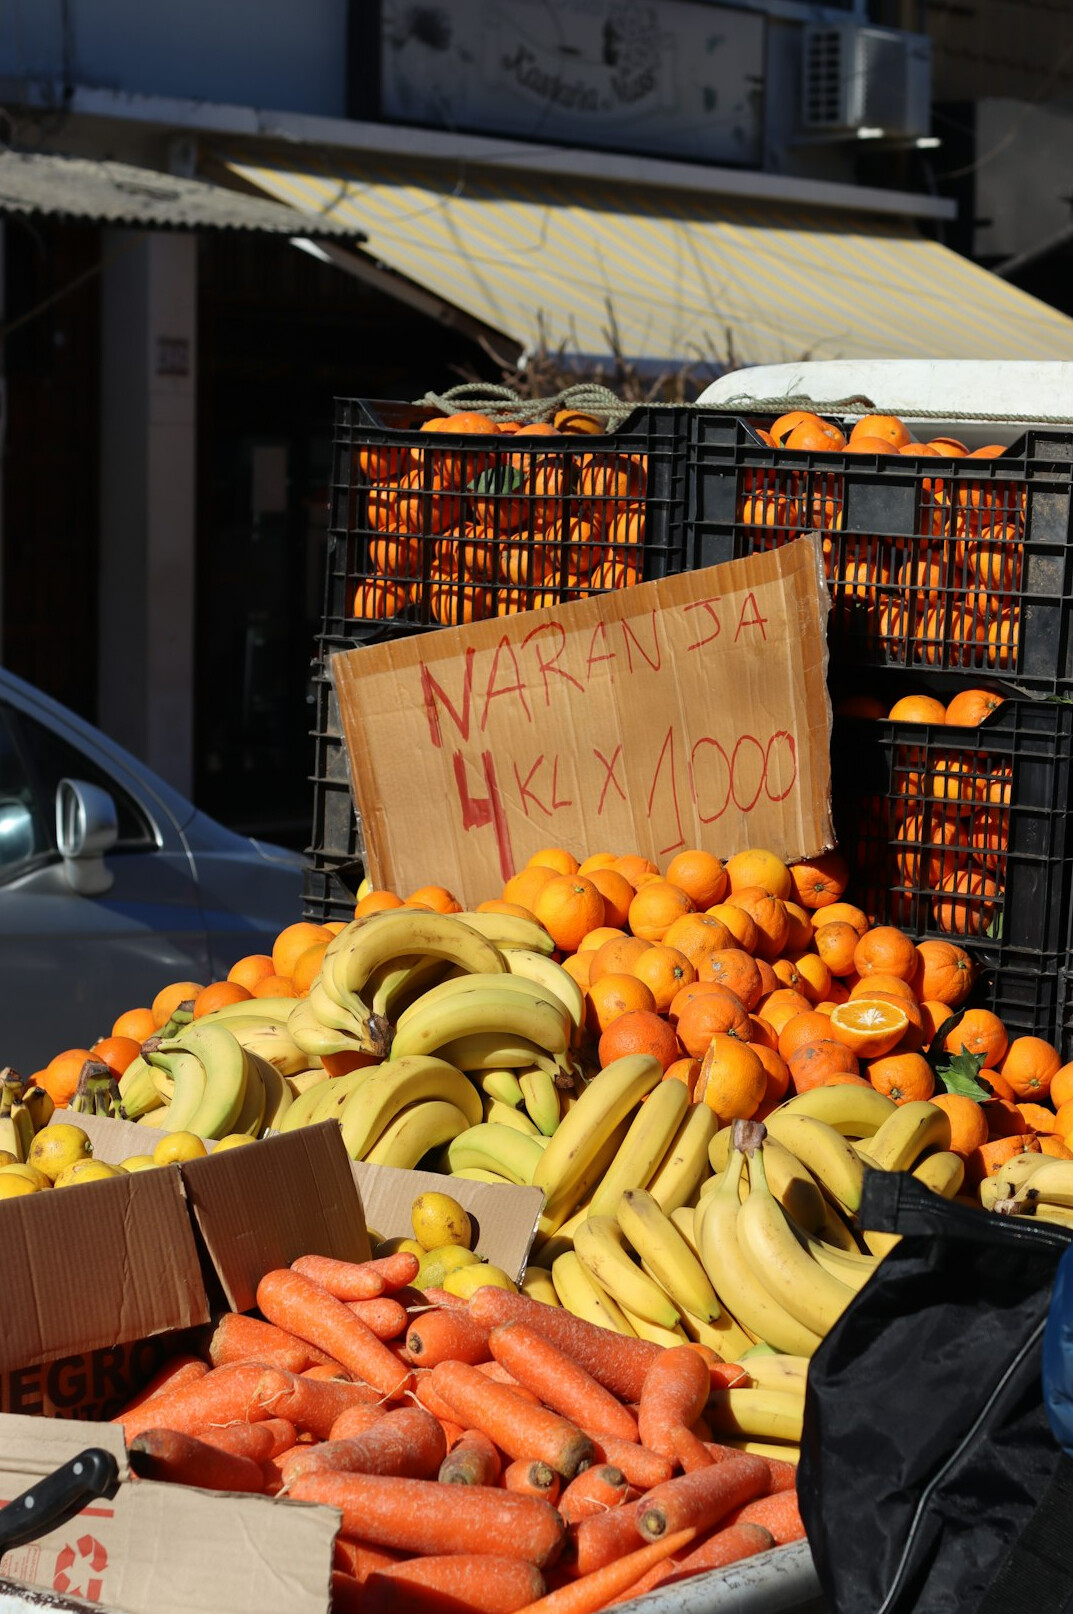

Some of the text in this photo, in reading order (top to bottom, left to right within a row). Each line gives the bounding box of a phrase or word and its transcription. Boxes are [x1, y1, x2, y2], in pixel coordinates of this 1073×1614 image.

[419, 592, 769, 748] NARANJA
[452, 749, 515, 884] 4
[513, 754, 572, 817] KL
[646, 726, 798, 855] 1000
[0, 1338, 165, 1416] EGRO
